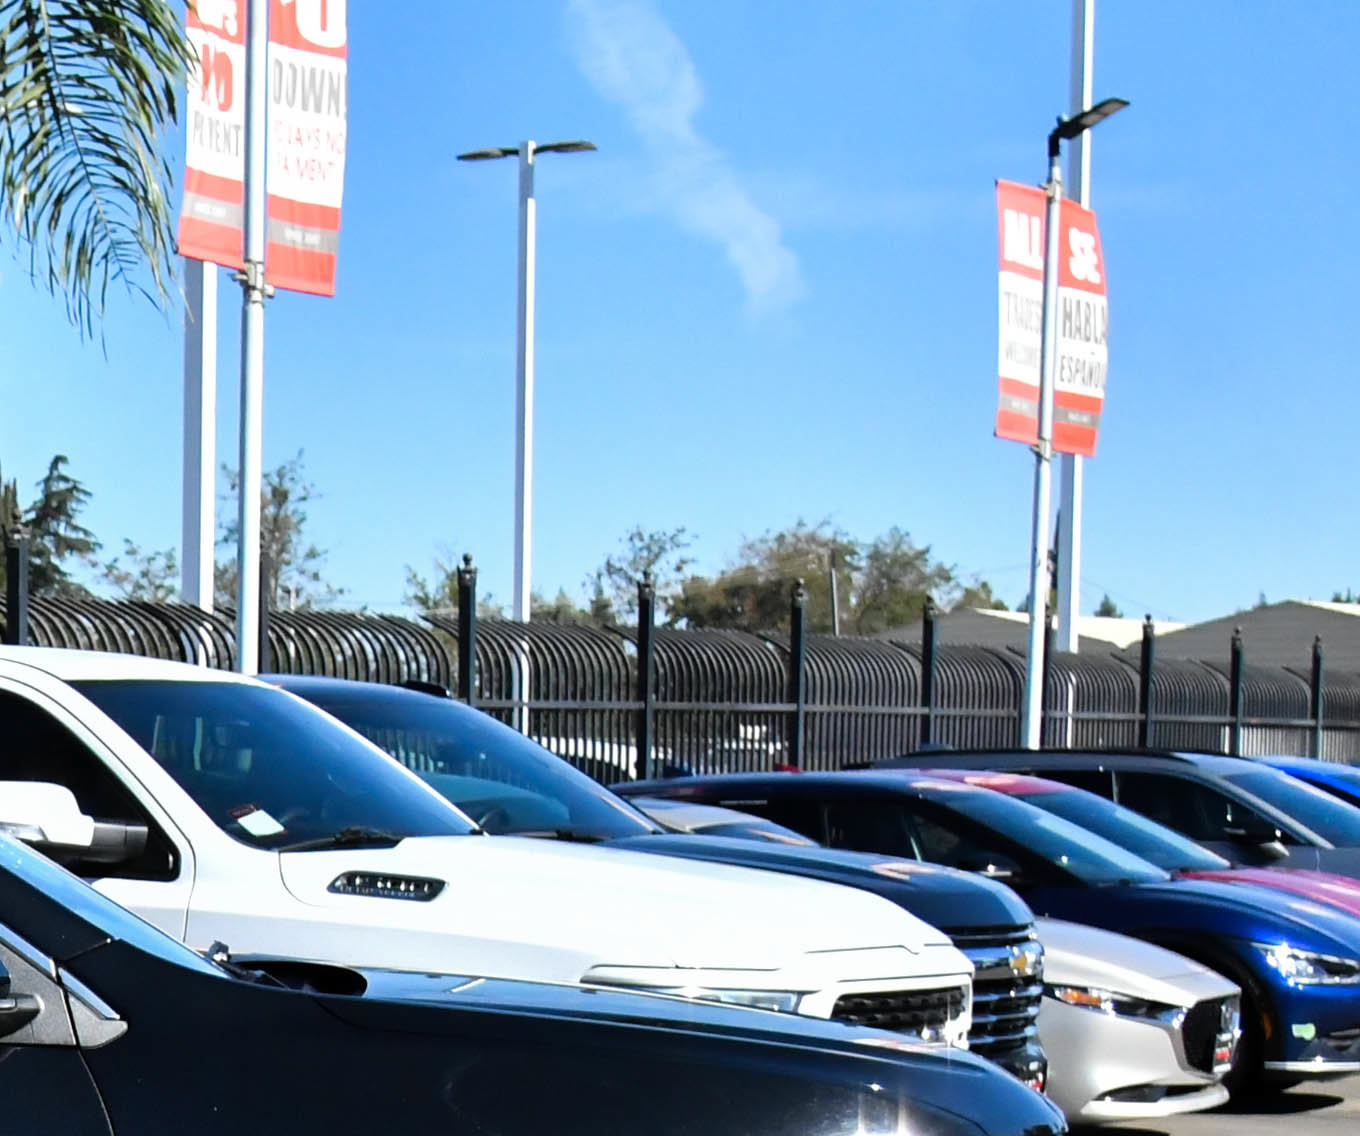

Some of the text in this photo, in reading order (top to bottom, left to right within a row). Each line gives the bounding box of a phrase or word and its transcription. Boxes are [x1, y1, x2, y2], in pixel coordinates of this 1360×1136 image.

[273, 58, 341, 117] DOWN
[275, 152, 335, 180] AMENT
[1068, 227, 1100, 284] SE
[1062, 296, 1106, 345] HABLA
